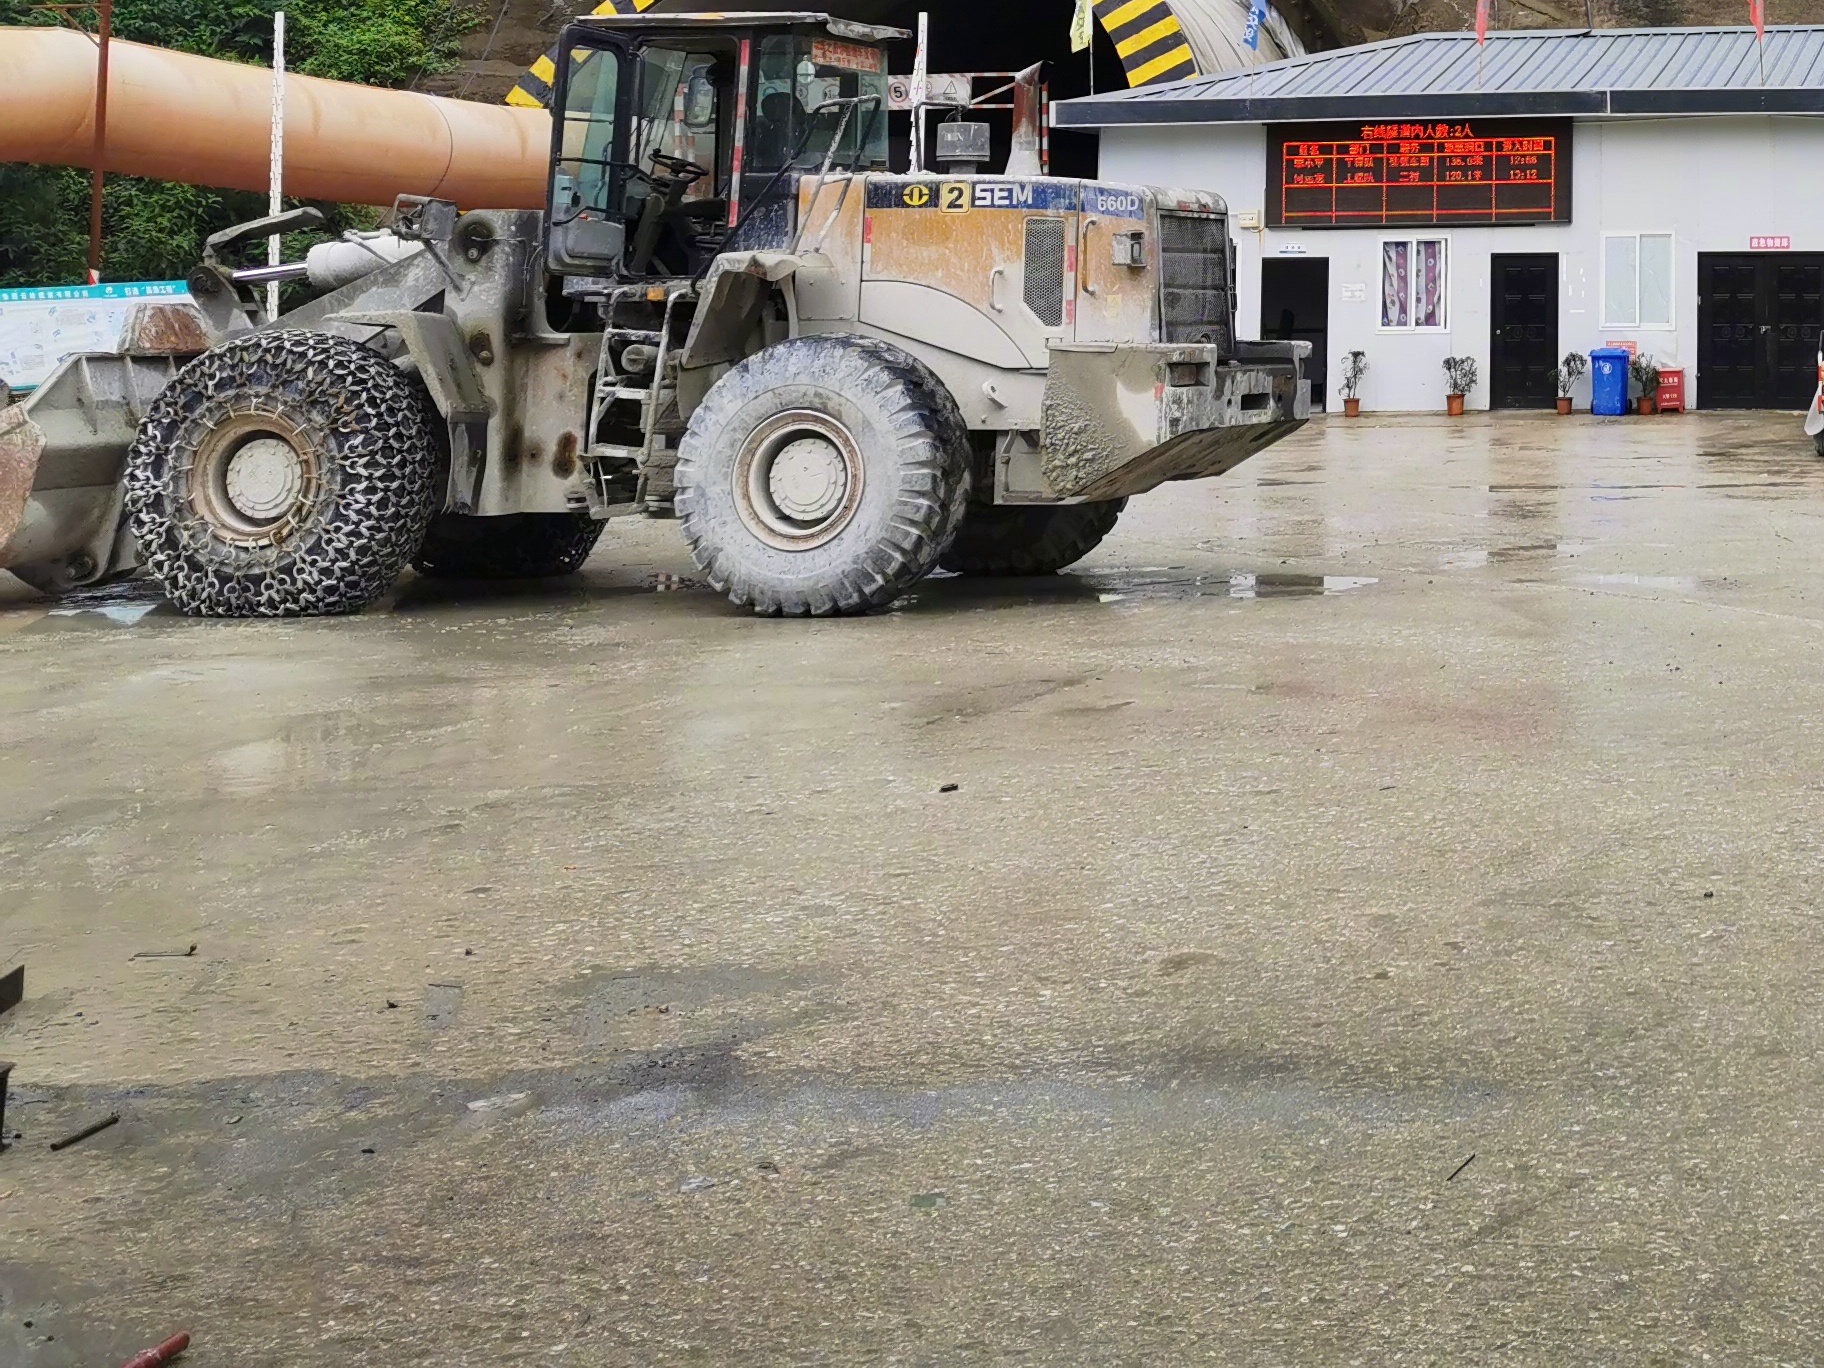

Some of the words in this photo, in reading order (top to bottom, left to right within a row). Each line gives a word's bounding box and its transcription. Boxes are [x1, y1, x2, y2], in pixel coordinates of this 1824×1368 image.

[893, 86, 903, 99] 5
[945, 186, 965, 209] 2
[974, 183, 1034, 206] SEM
[1097, 194, 1140, 212] 660D
